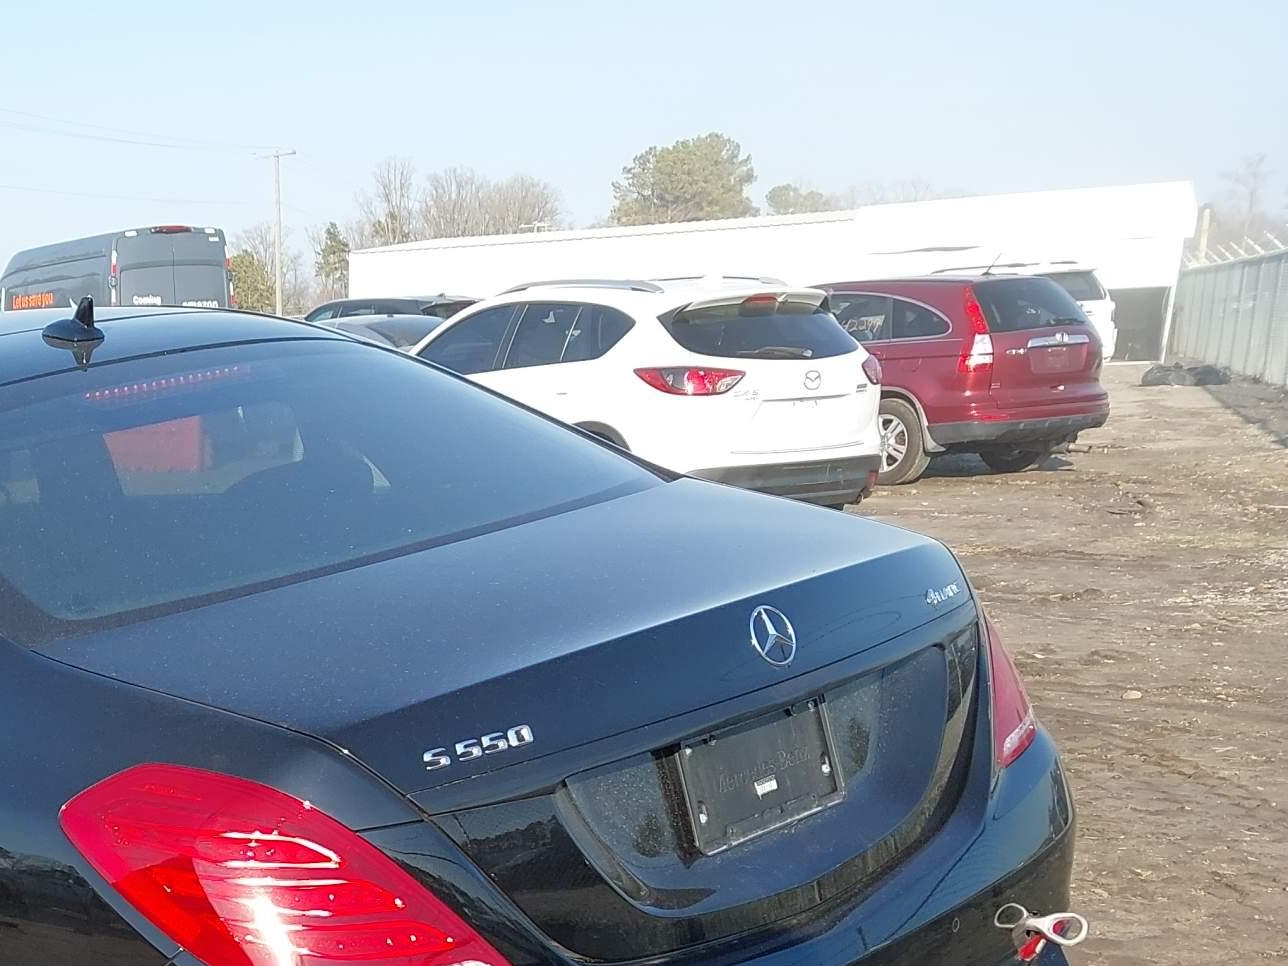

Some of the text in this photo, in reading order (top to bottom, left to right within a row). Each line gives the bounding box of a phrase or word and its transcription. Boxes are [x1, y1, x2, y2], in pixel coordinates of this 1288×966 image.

[133, 294, 161, 305] Coming
[423, 724, 534, 770] S 550
